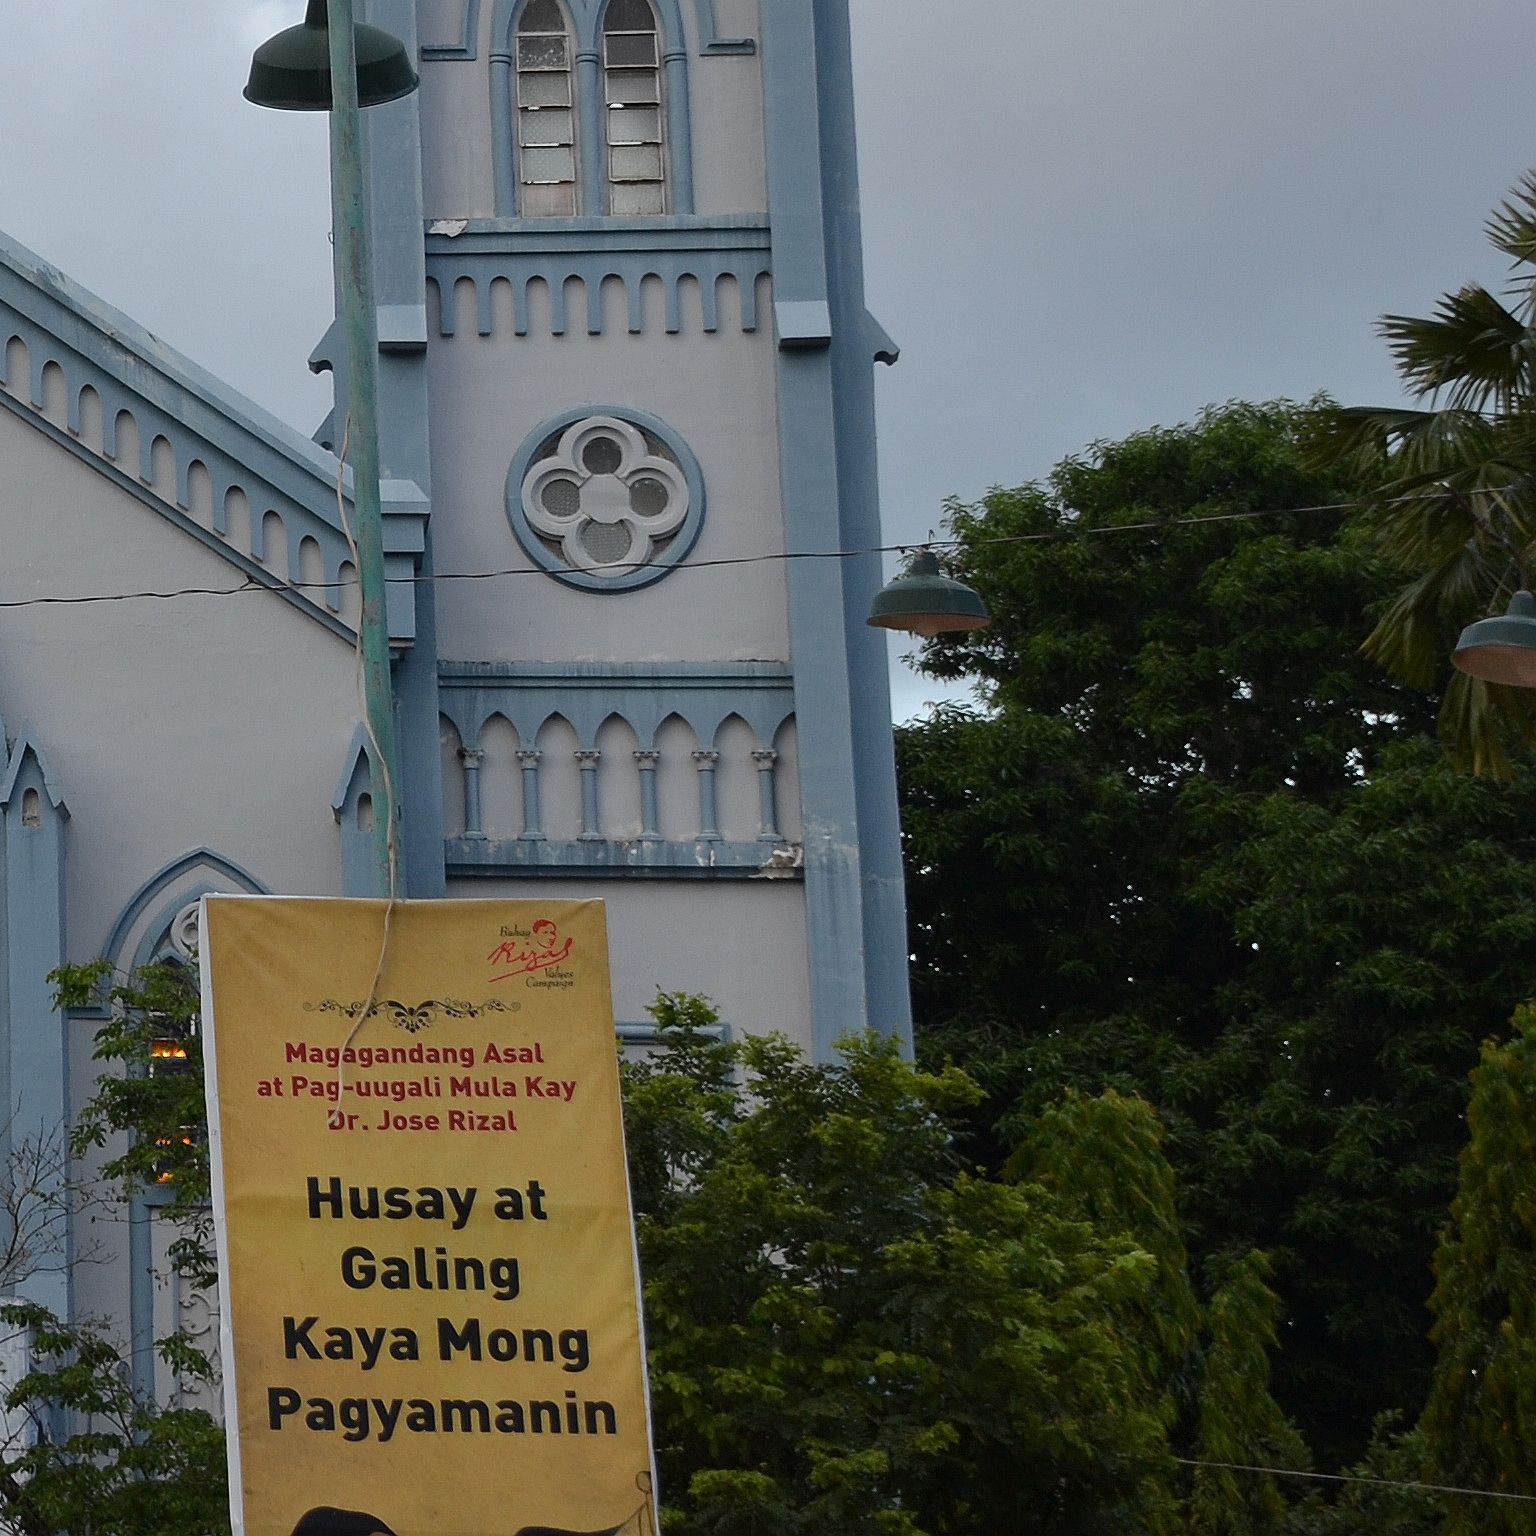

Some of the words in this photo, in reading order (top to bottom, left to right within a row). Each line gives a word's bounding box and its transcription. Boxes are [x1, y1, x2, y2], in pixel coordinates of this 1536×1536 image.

[487, 937, 573, 982] Rizal
[284, 1042, 475, 1067] Magagandang
[483, 1042, 544, 1064] Asal
[257, 1076, 283, 1097] at
[291, 1076, 441, 1102] Pag-uugali
[450, 1076, 517, 1097] Mula
[525, 1076, 577, 1102] Kay
[328, 1109, 369, 1131] Dr.
[377, 1109, 440, 1131] Jose
[448, 1109, 517, 1132] Rizal
[307, 1176, 477, 1230] Husay
[494, 1178, 548, 1220] at
[341, 1246, 520, 1301] Galing
[283, 1316, 419, 1371] Kaya
[438, 1318, 590, 1373] Mong
[267, 1386, 617, 1441] Pagyamanin
